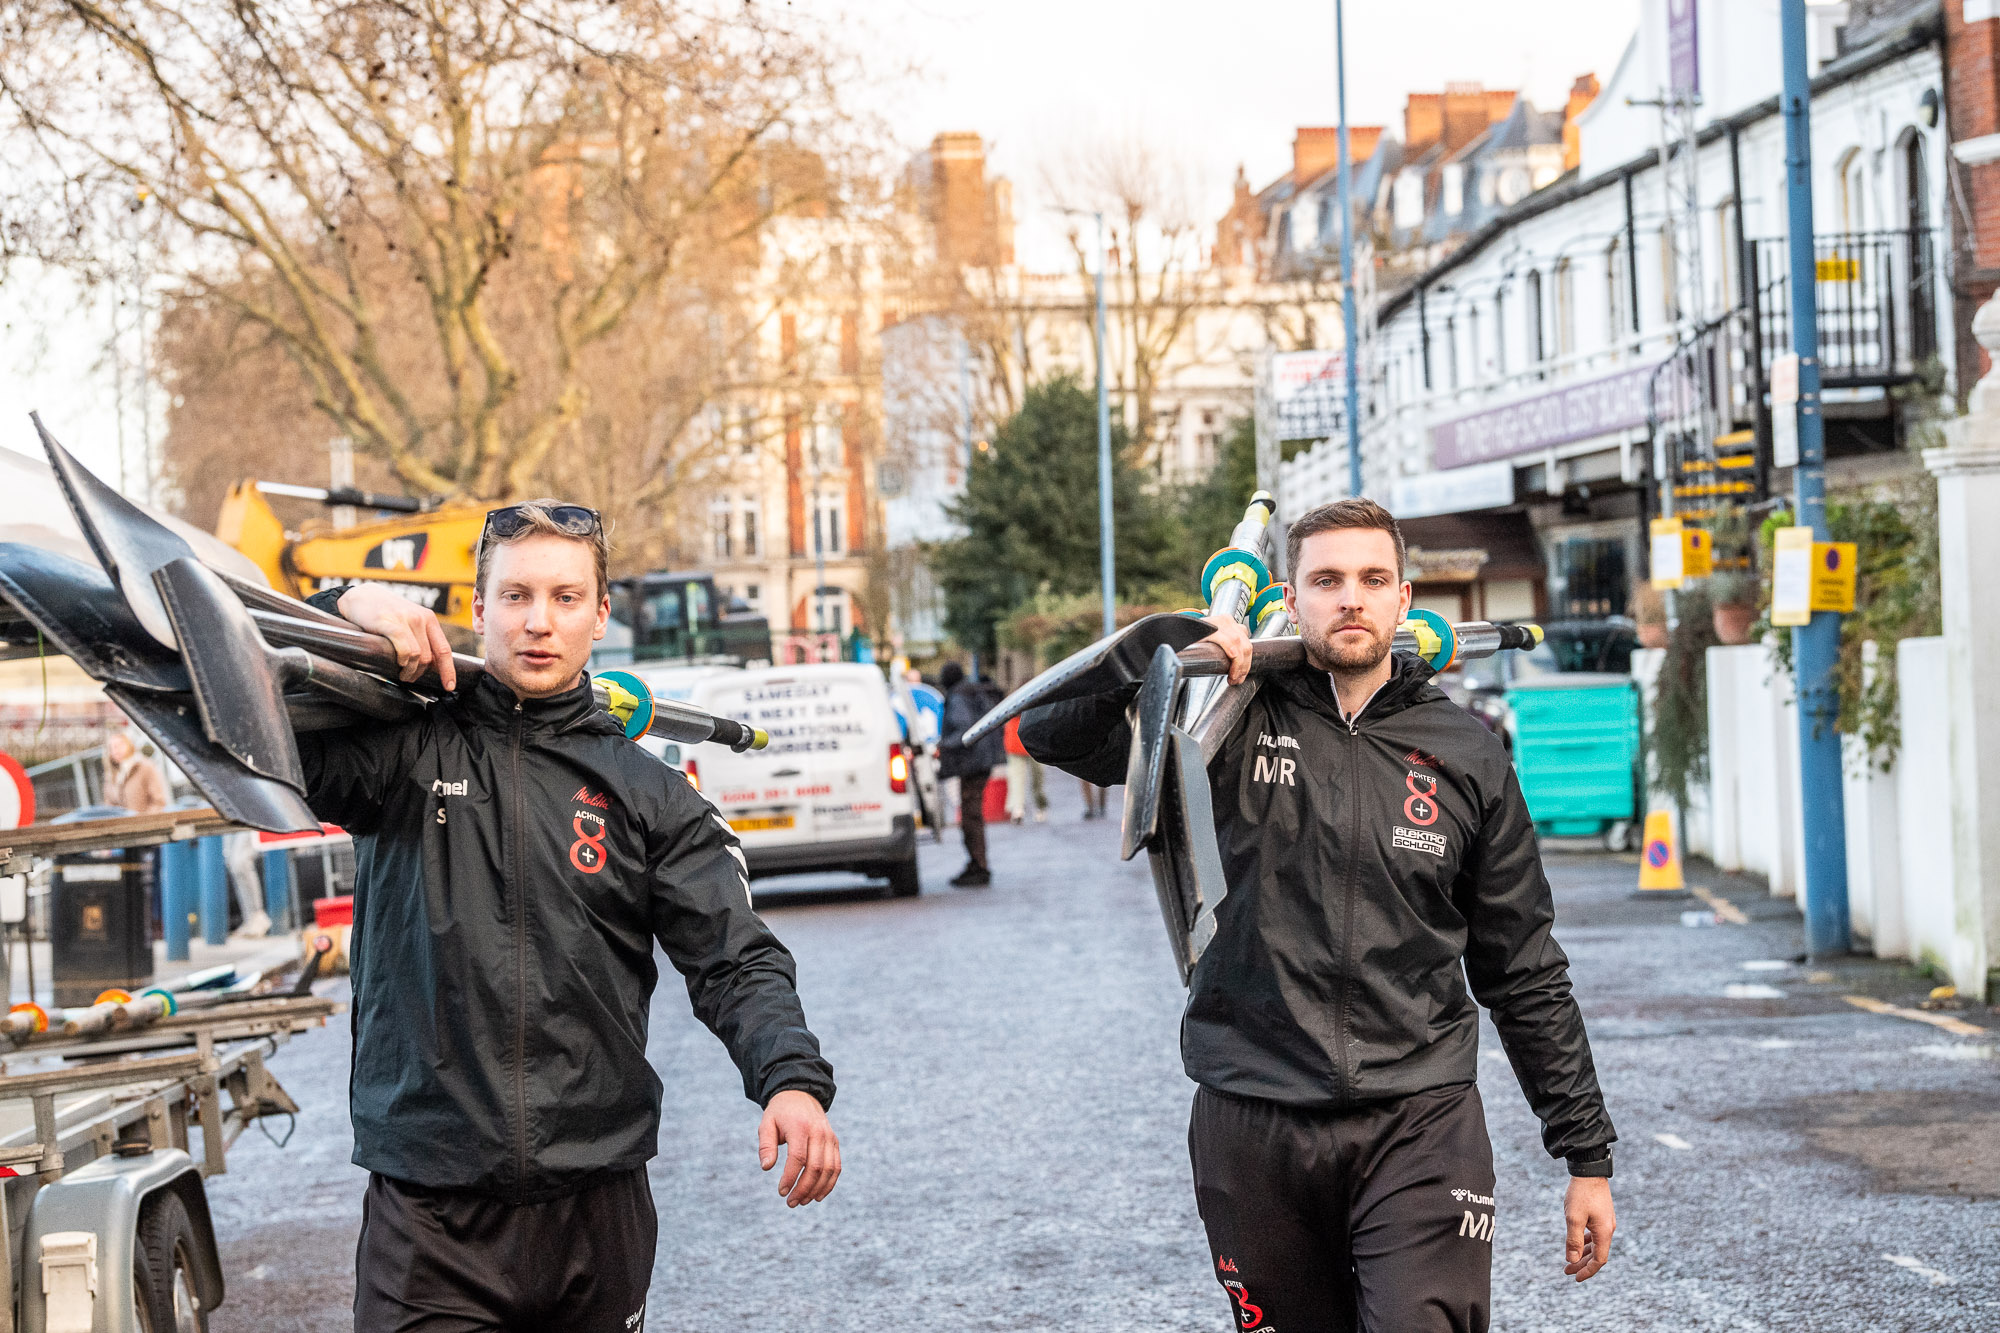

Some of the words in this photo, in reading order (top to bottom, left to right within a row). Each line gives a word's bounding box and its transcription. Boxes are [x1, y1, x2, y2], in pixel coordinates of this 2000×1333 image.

[1253, 755, 1296, 786] MR
[1408, 770, 1437, 785] ACHTER
[575, 810, 606, 827] ACHTER
